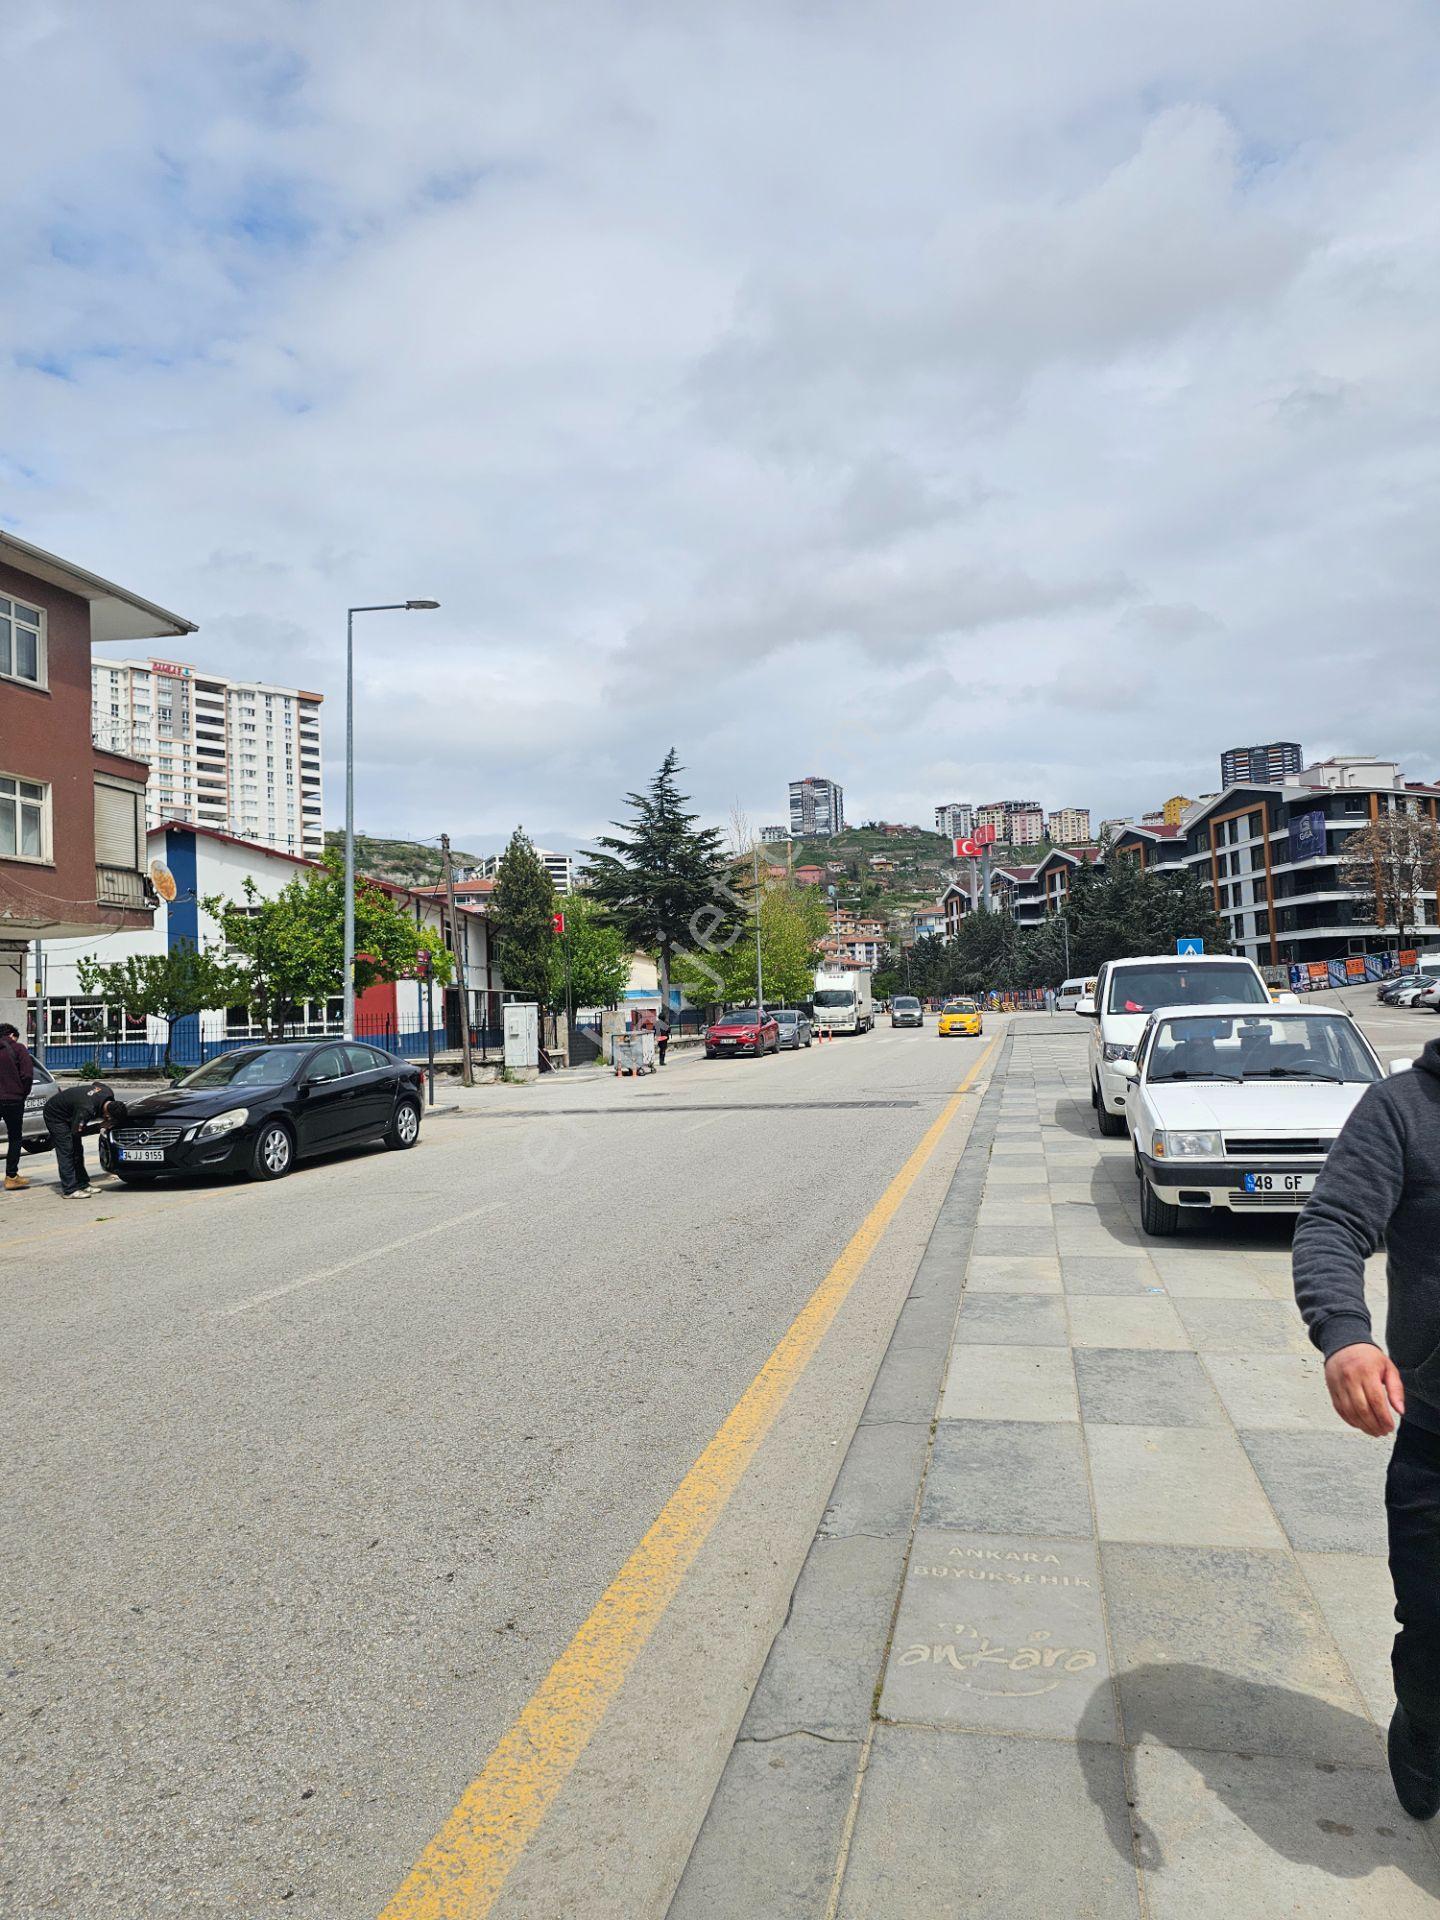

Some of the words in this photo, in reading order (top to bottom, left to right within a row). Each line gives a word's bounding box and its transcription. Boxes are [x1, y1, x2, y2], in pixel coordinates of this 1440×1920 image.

[123, 1151, 132, 1160] 34
[134, 1151, 143, 1160] JJ
[145, 1151, 162, 1160] 9155
[1255, 1175, 1273, 1190] 48
[1284, 1175, 1302, 1190] GF
[949, 1547, 1060, 1567] ANKARA
